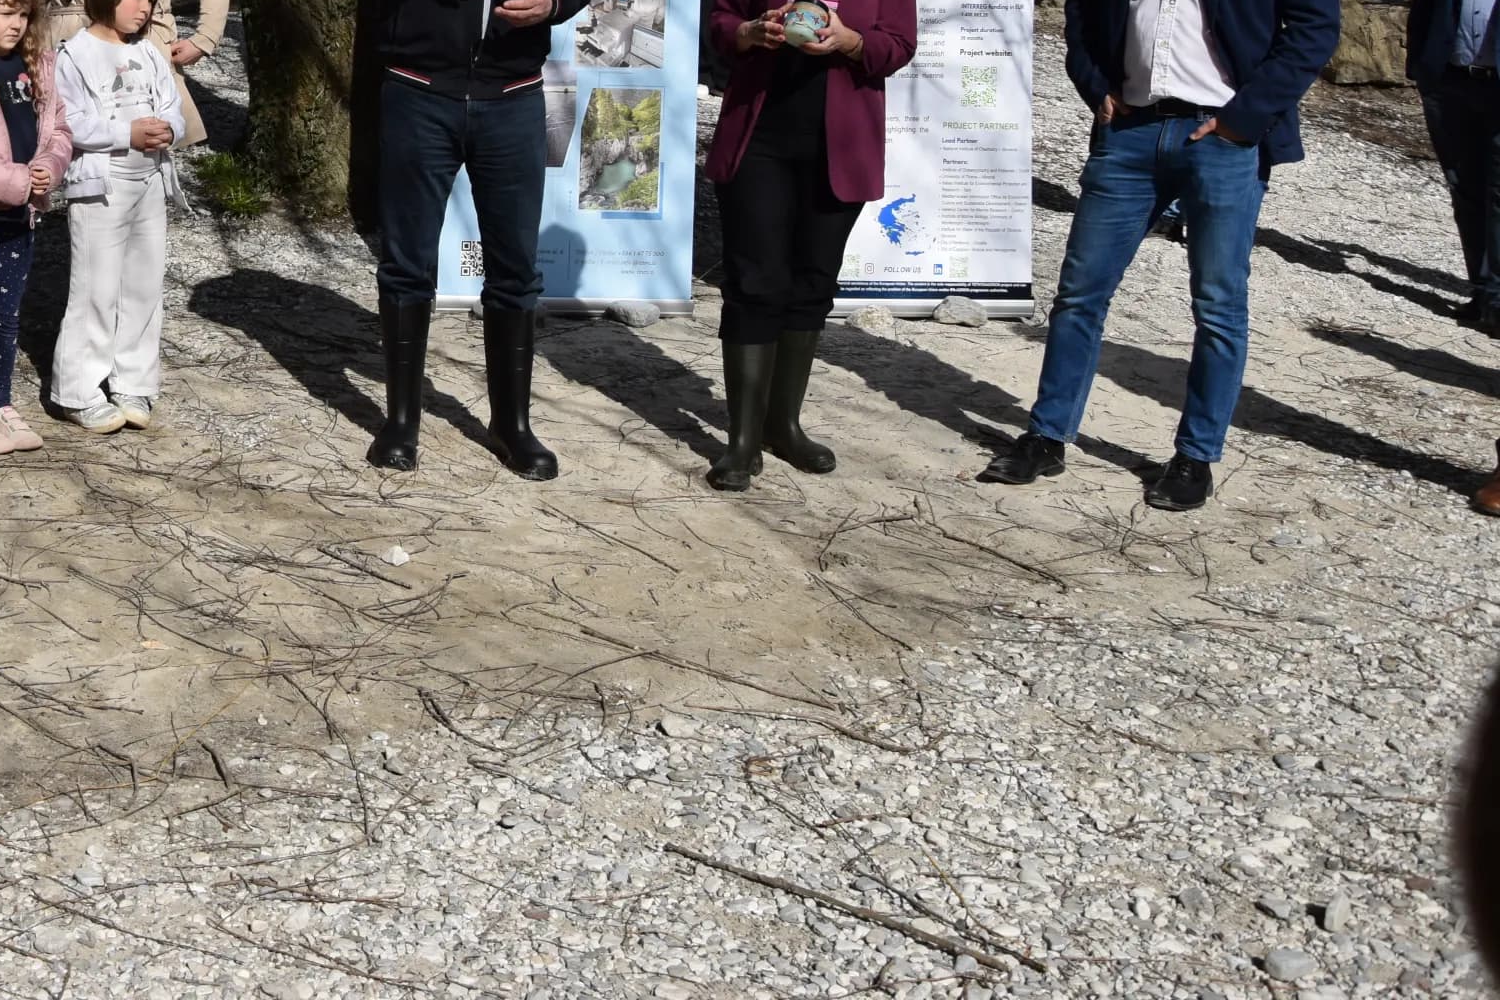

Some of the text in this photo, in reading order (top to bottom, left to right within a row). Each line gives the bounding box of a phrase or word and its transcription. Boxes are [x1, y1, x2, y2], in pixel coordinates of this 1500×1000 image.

[959, 49, 983, 58] Project
[943, 121, 1019, 131] PROJECT PARTNERS
[912, 266, 922, 274] US
